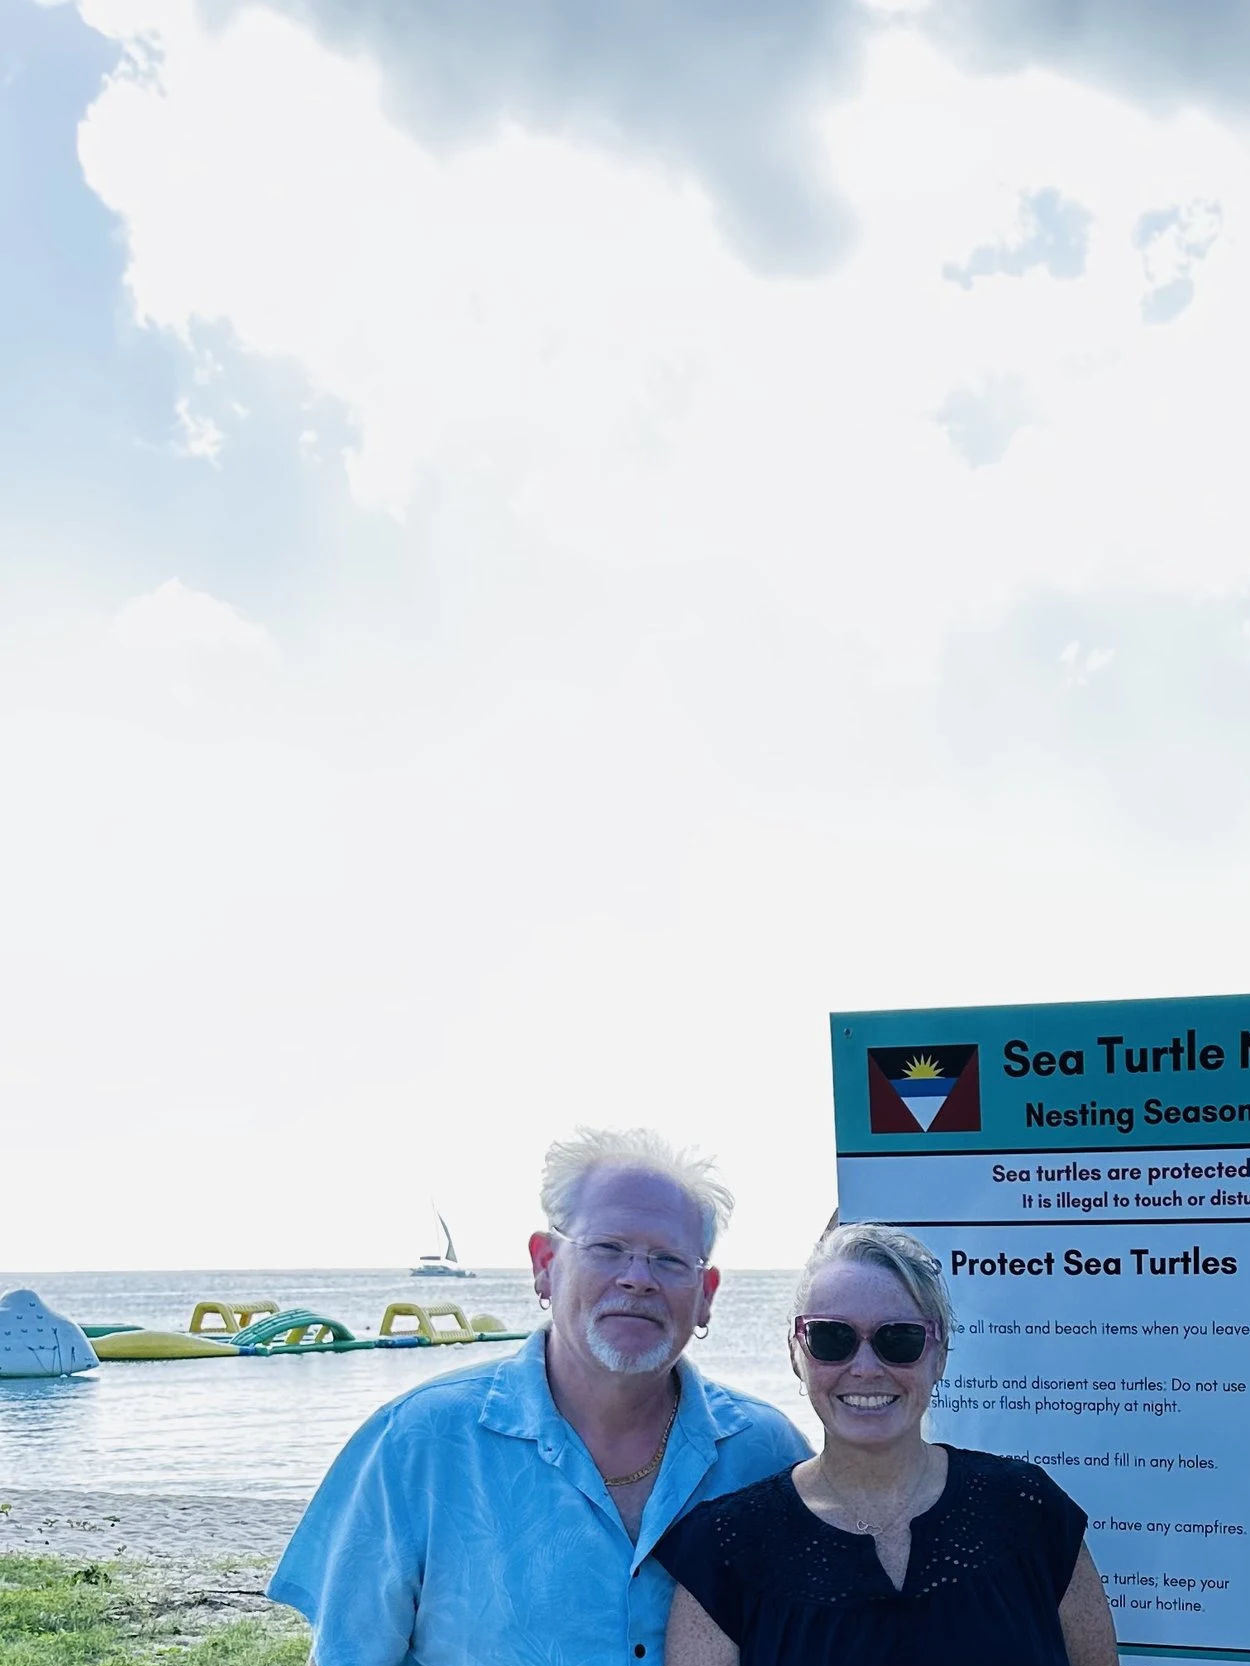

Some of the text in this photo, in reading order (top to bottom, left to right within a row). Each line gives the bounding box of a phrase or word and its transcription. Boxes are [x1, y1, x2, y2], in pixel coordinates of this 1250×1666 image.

[1003, 1040, 1084, 1077] Sea
[1097, 1029, 1224, 1074] Turtle
[1026, 1101, 1134, 1133] Nesting
[993, 1164, 1030, 1183] Sea
[1036, 1162, 1101, 1181] turtles
[1107, 1166, 1142, 1180] are
[1148, 1158, 1250, 1185] protected
[1022, 1194, 1033, 1208] It
[1038, 1193, 1052, 1208] is
[1056, 1192, 1108, 1212] illegal
[1113, 1194, 1128, 1207] to
[1134, 1190, 1182, 1207] touch
[1187, 1195, 1206, 1206] or
[951, 1250, 1055, 1276] Protect
[1063, 1249, 1121, 1276] Sea
[1130, 1246, 1238, 1276] Turtles
[969, 1320, 985, 1334] all
[988, 1320, 1021, 1334] trash
[1025, 1321, 1050, 1335] and
[1055, 1320, 1097, 1335] beach
[1102, 1321, 1138, 1335] items
[1141, 1321, 1179, 1335] when
[1183, 1325, 1208, 1340] you
[954, 1374, 998, 1389] disturb
[1002, 1375, 1027, 1389] and
[1031, 1375, 1088, 1391] disorient
[1092, 1380, 1116, 1391] sea
[1171, 1378, 1191, 1392] Do
[1195, 1380, 1218, 1392] not
[1223, 1381, 1246, 1393] use
[931, 1394, 1182, 1416] shlights or flash photography at night.
[1033, 1451, 1080, 1466] castles
[1084, 1453, 1109, 1467] and
[1114, 1453, 1129, 1467] fill
[1134, 1455, 1145, 1467] in
[1150, 1458, 1174, 1472] any
[1179, 1454, 1218, 1470] holes.
[1093, 1521, 1106, 1530] or
[1110, 1516, 1142, 1531] have
[1147, 1522, 1171, 1536] any
[1175, 1520, 1247, 1538] campfires.
[1164, 1573, 1196, 1592] keep
[1201, 1577, 1229, 1592] your
[1131, 1598, 1152, 1609] our
[1156, 1596, 1206, 1612] hotline.
